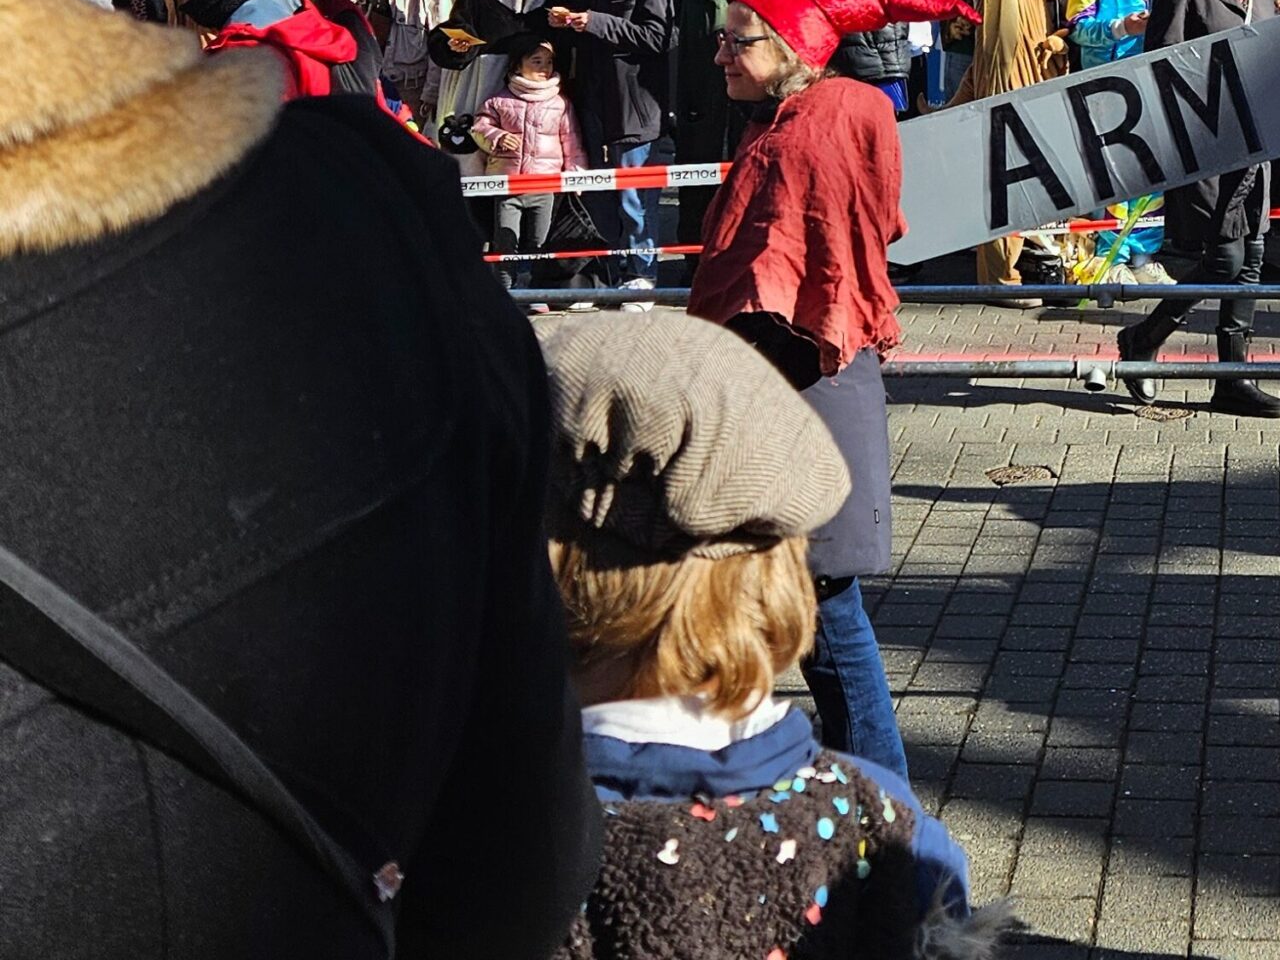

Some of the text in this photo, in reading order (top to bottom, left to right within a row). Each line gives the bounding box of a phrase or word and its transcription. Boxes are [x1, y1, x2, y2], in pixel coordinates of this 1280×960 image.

[990, 38, 1263, 230] ARM
[564, 174, 611, 186] POLIZEI
[671, 169, 717, 180] POLIZEI
[461, 180, 504, 191] POLIZE
